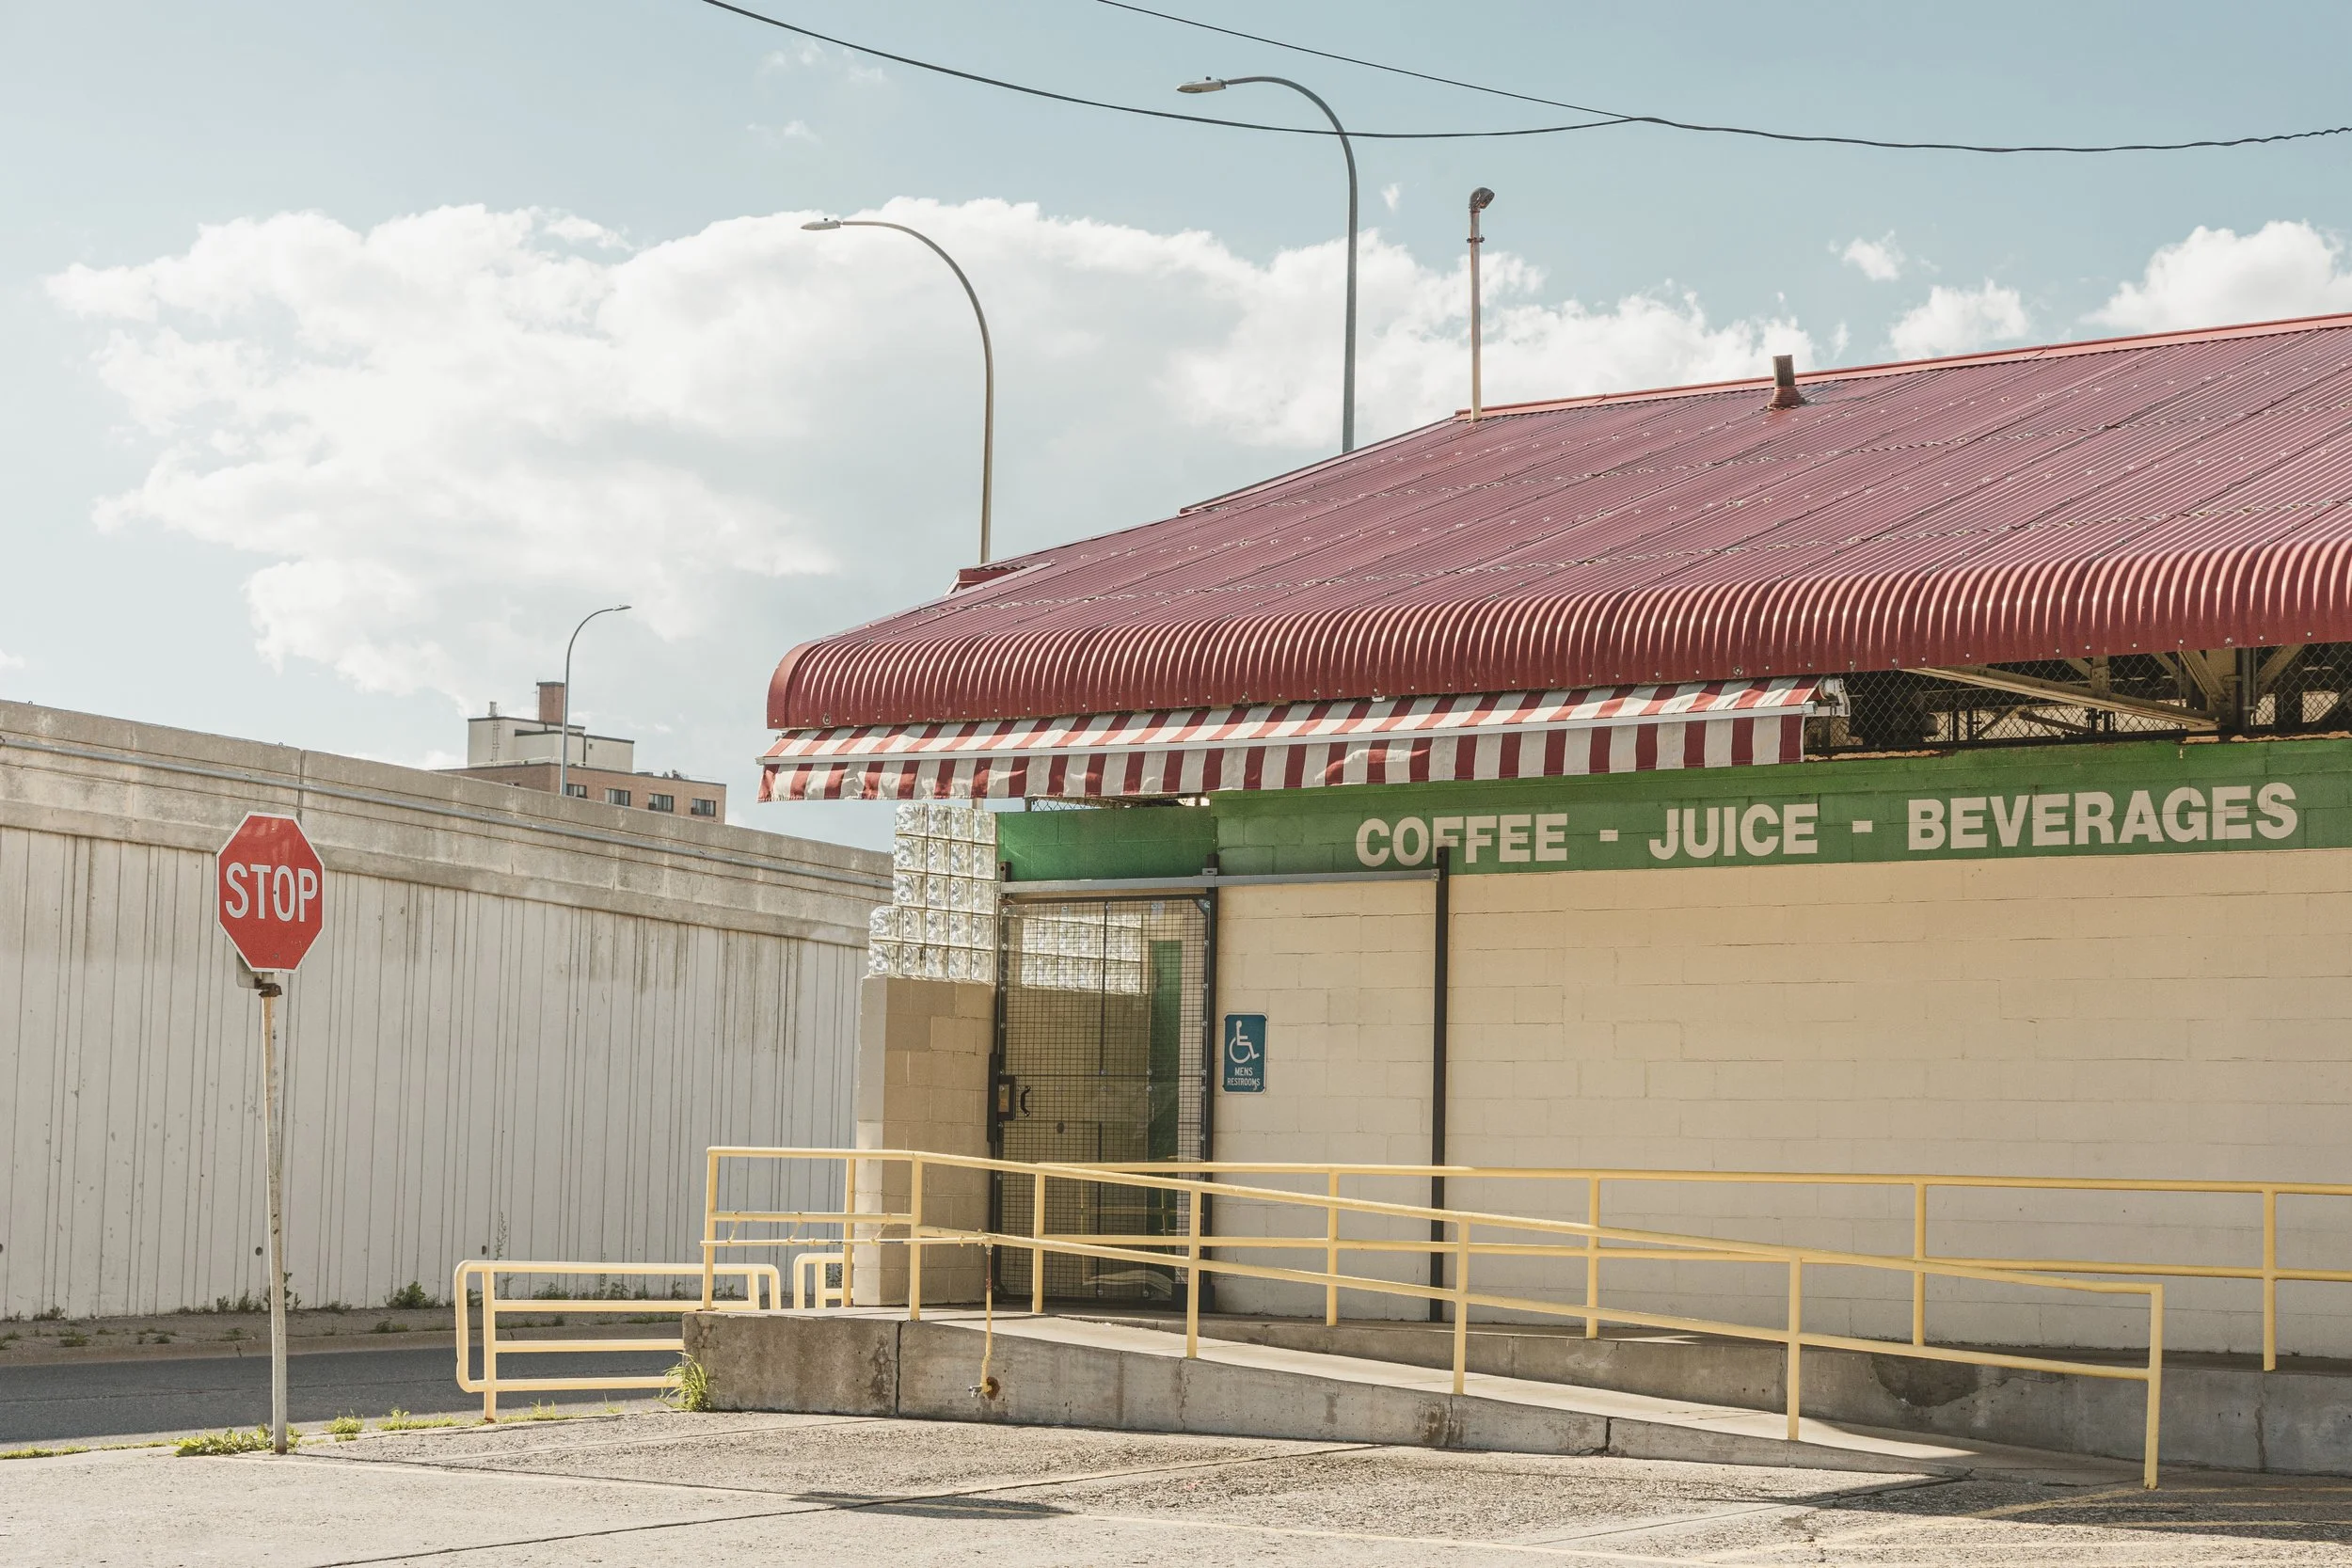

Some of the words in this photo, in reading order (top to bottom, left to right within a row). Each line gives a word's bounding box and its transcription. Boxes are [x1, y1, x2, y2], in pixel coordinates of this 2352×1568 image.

[1356, 813, 1568, 867] COFFEE
[1648, 803, 1819, 861] JUICE
[1907, 782, 2298, 851] BEVERAGES
[226, 863, 318, 922] STOP
[1227, 1077, 1260, 1086] RESTROOMS
[1234, 1067, 1253, 1076] MENS
